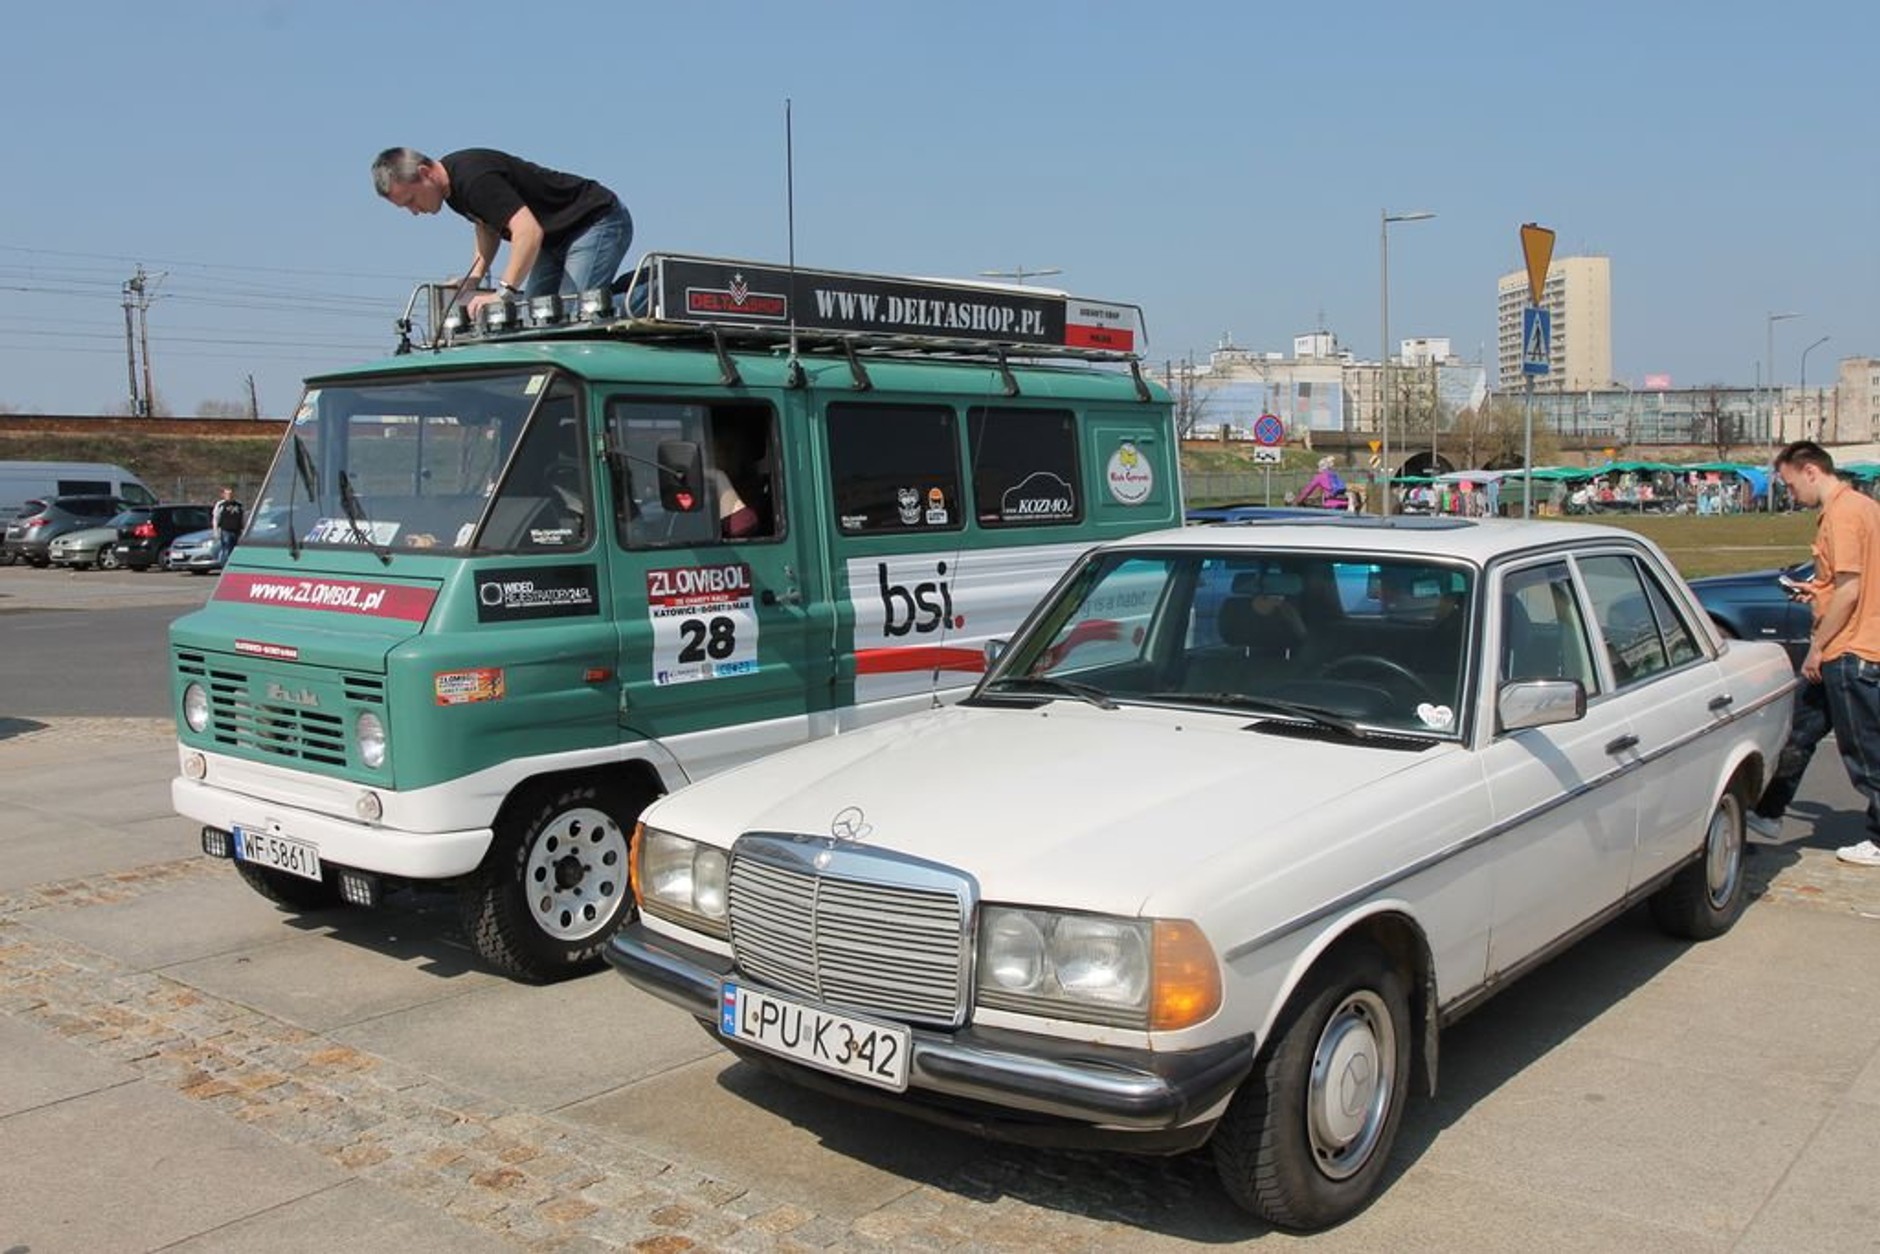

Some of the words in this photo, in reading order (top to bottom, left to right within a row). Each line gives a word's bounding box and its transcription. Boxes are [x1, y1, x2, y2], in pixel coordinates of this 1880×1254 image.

[814, 289, 1044, 335] WWW.DELTASHOP.PL
[678, 616, 736, 664] 28
[244, 832, 264, 861] WF
[270, 838, 317, 876] 5861J
[742, 994, 802, 1048] LPU
[813, 1014, 898, 1079] K342
